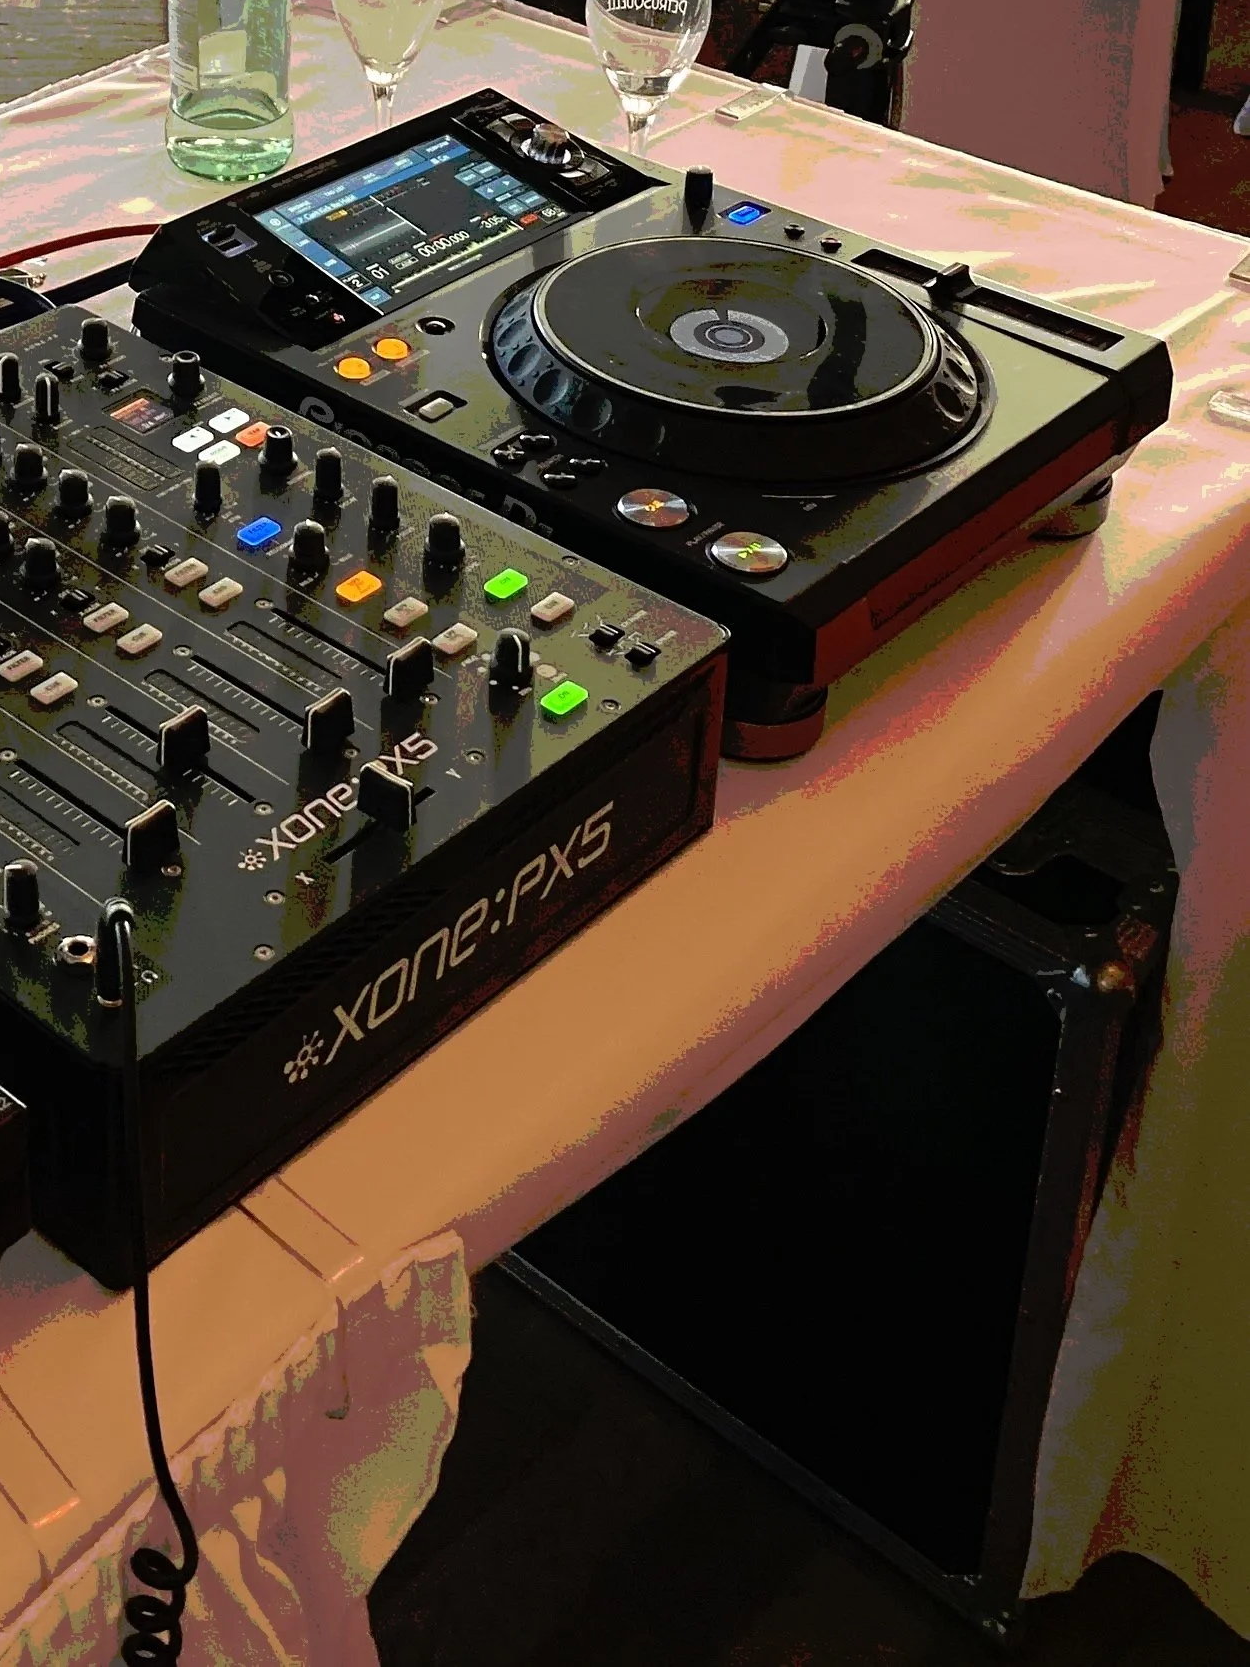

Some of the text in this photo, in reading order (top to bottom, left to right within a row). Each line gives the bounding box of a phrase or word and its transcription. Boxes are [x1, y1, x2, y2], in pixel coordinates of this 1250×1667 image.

[417, 230, 470, 258] 00:00.000
[351, 278, 364, 289] 2
[6, 655, 31, 671] FILTER
[444, 767, 462, 781] Y
[295, 870, 315, 887] X
